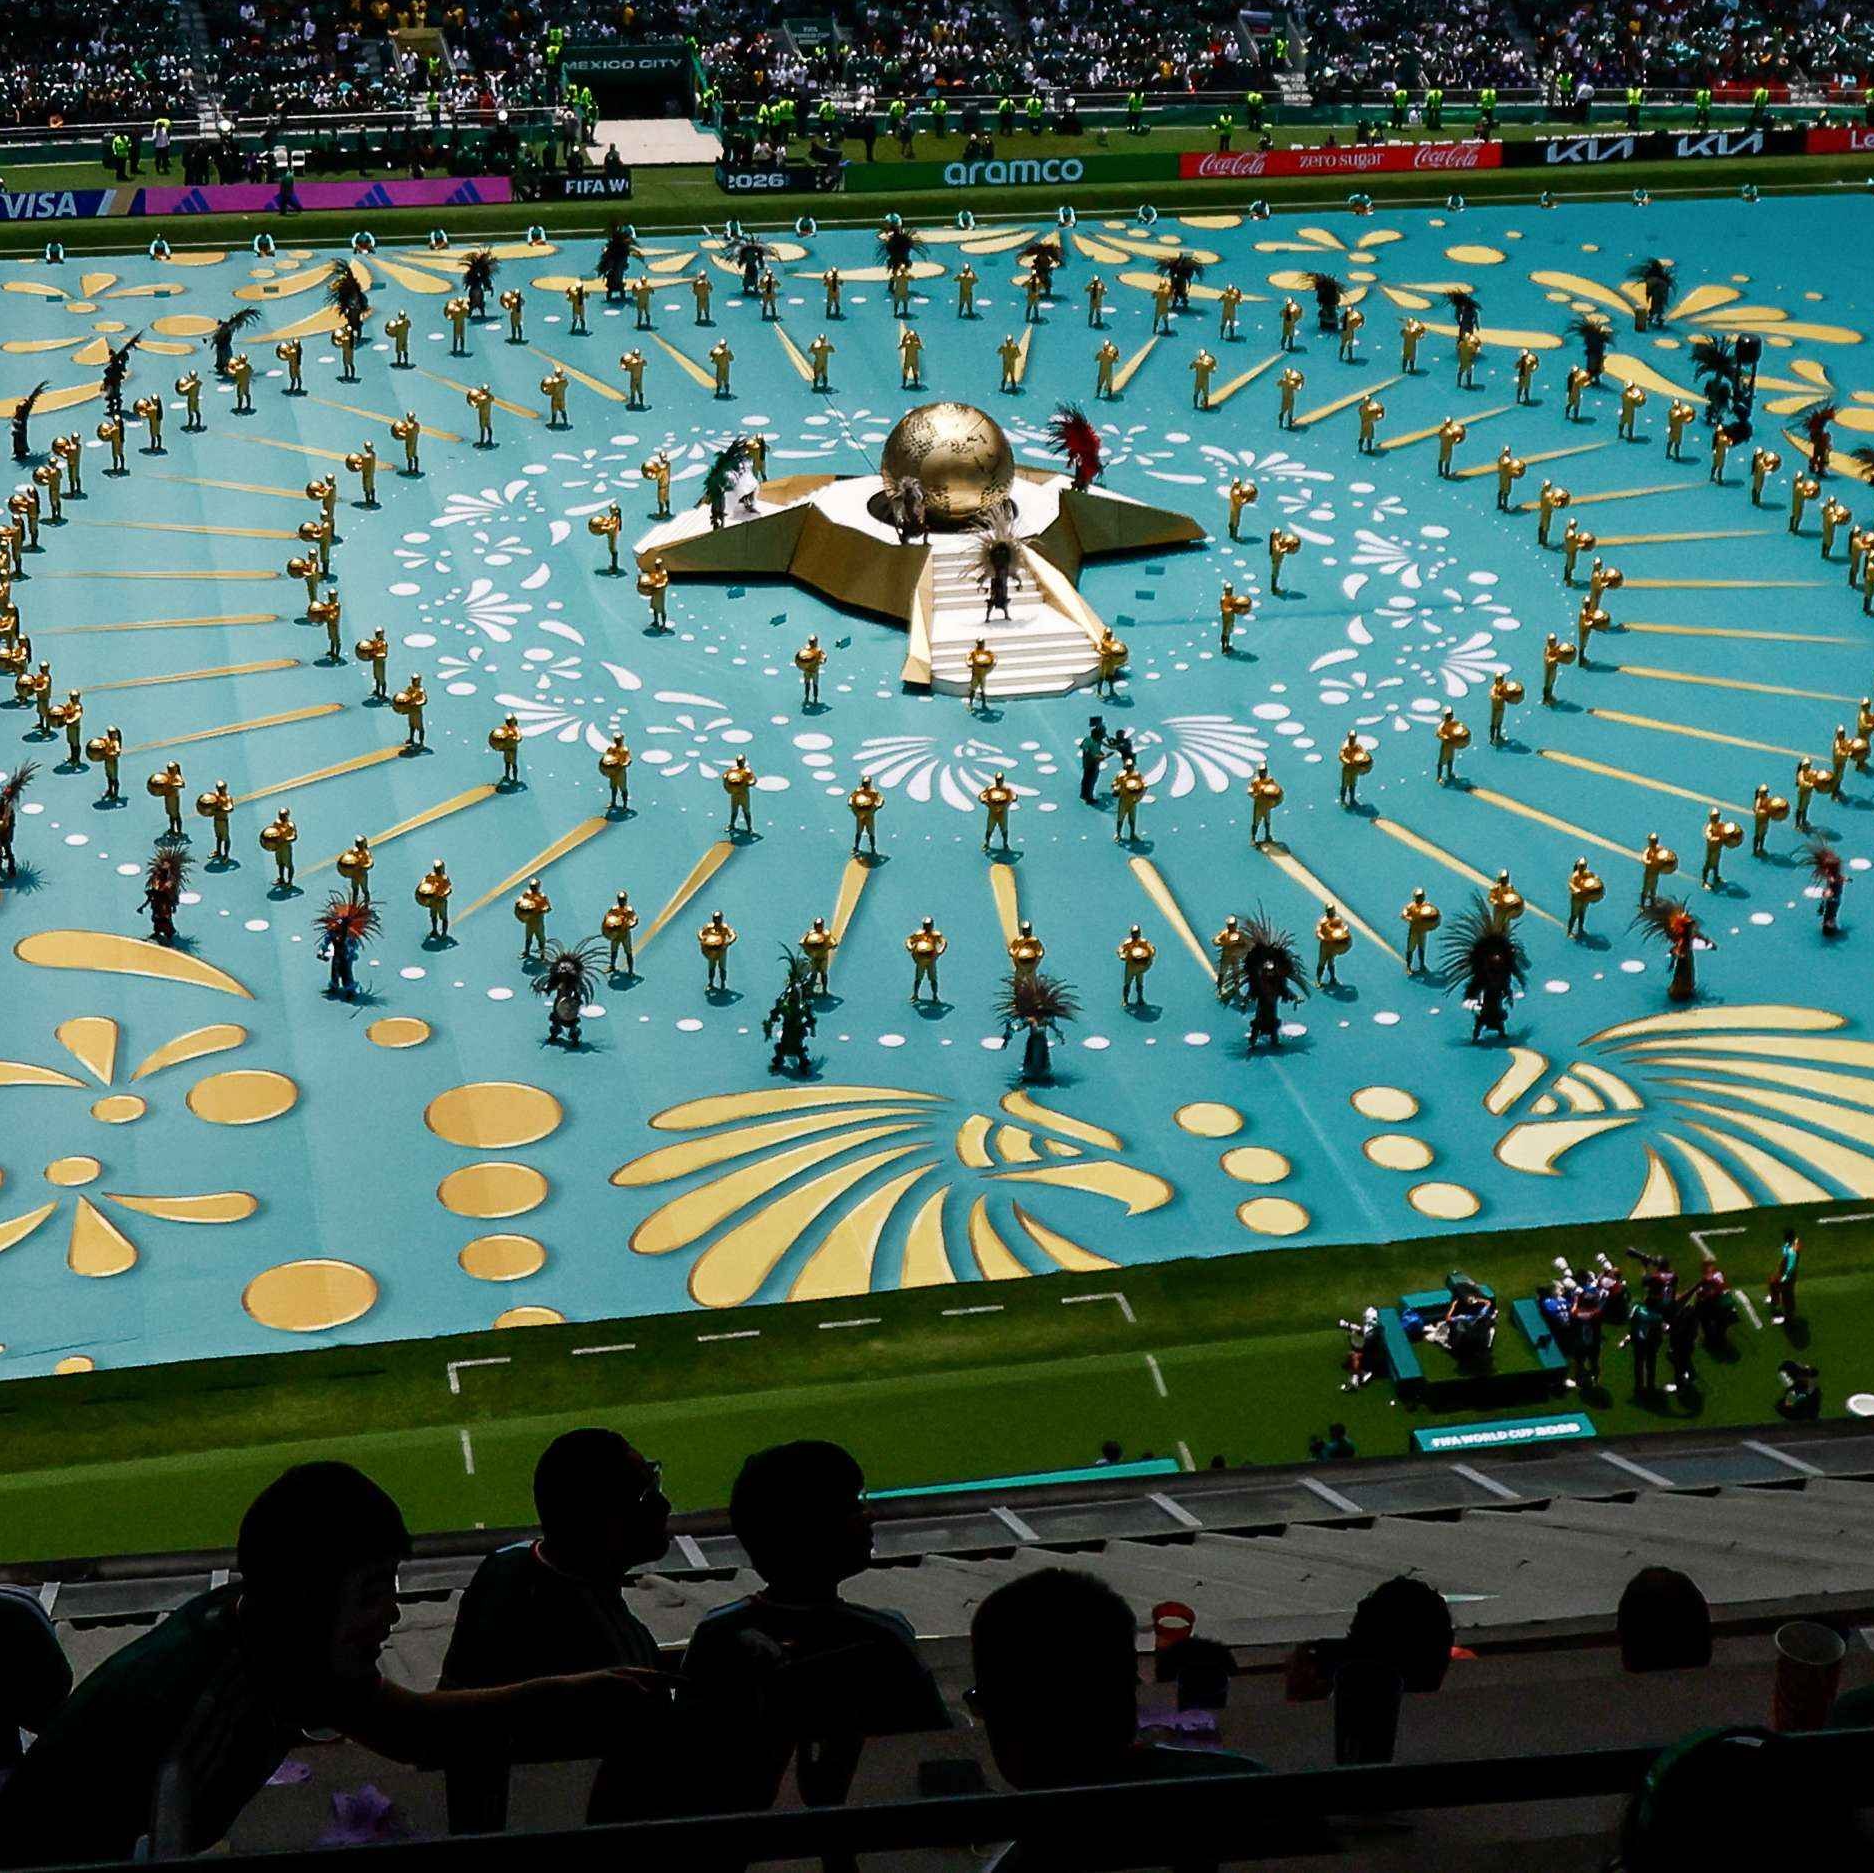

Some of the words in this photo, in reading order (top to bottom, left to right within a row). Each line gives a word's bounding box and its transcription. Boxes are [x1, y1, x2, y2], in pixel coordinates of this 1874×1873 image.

[563, 59, 635, 71] MEXICO
[639, 58, 684, 70] CITY
[1544, 134, 1641, 165] KIA
[1674, 129, 1767, 159] KIA
[942, 156, 1086, 188] aramco
[1299, 154, 1337, 169] zero
[1338, 151, 1384, 171] sugar
[565, 178, 606, 196] FIFA
[728, 173, 785, 190] 2026
[0, 191, 79, 220] VISA
[1431, 1437, 1462, 1449] FIFA
[1462, 1430, 1508, 1445] WORLD
[1508, 1427, 1534, 1440] CUP
